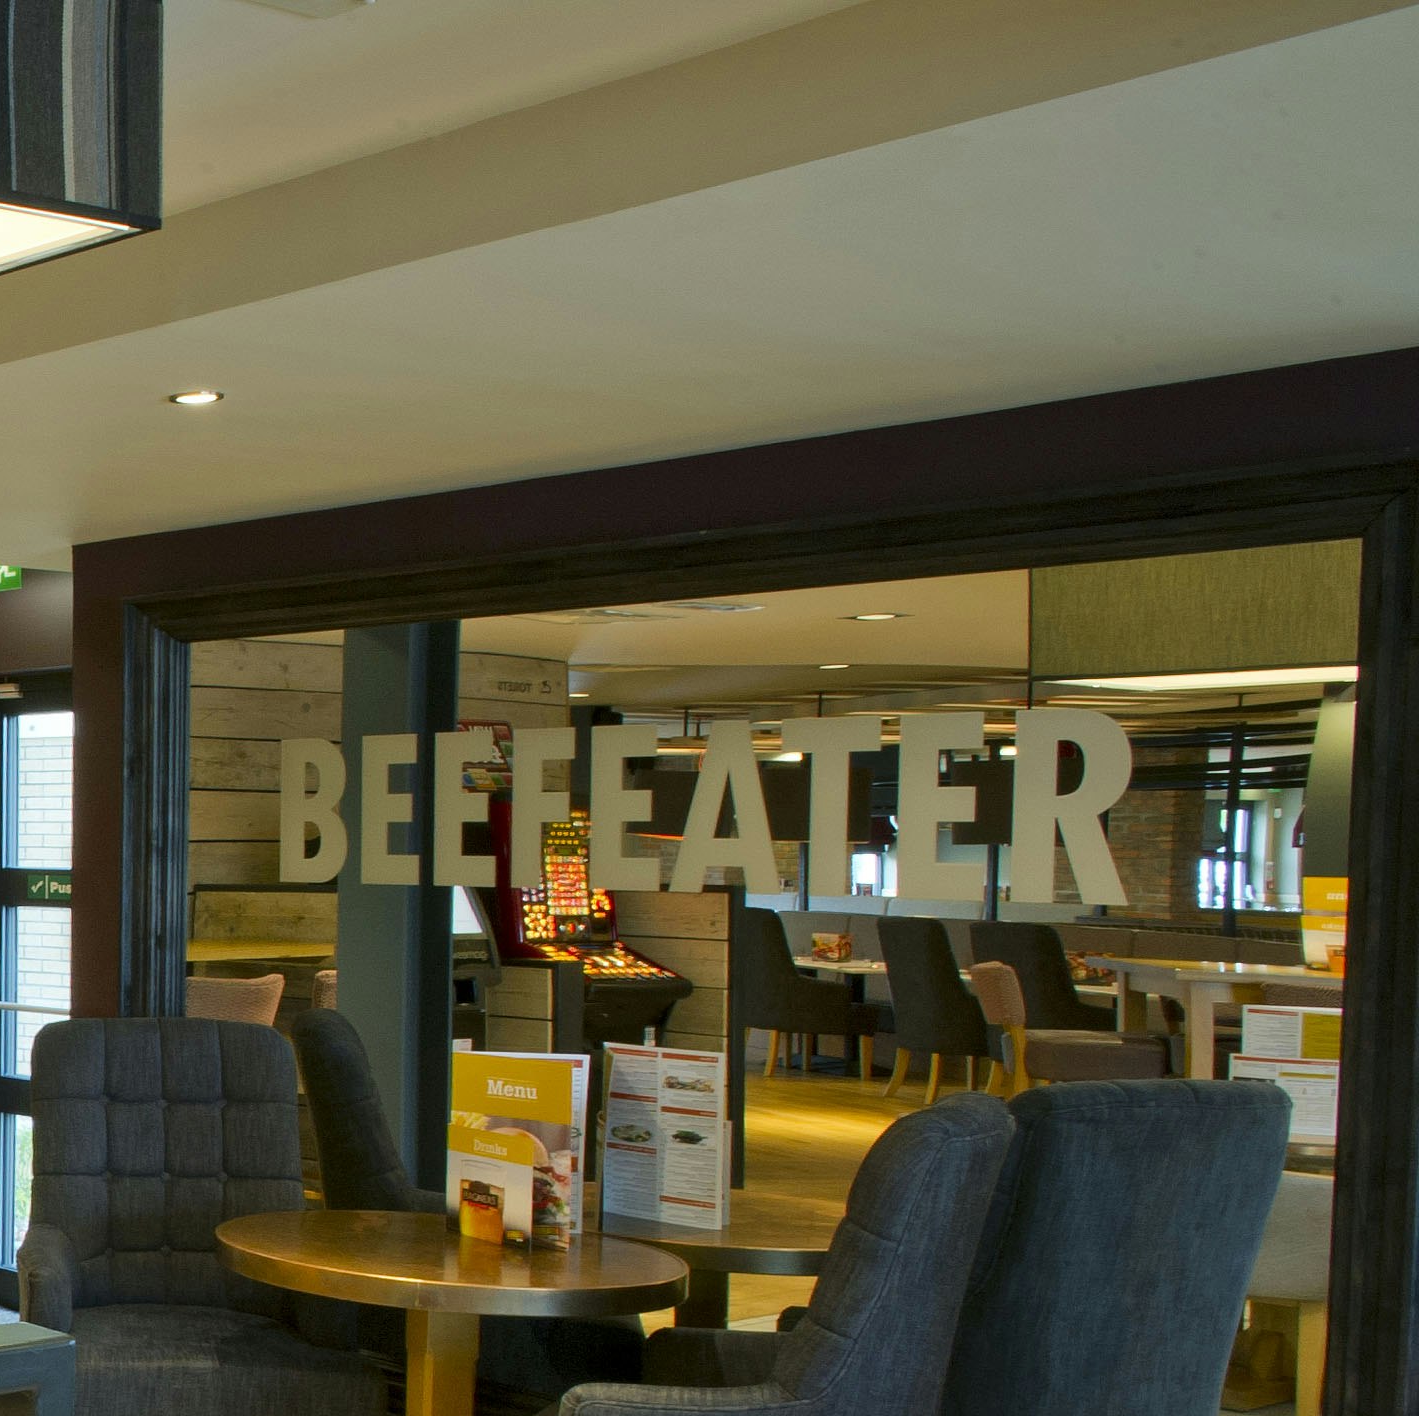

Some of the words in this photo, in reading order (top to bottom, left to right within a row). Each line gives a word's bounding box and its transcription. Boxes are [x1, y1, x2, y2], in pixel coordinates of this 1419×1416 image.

[278, 708, 1134, 907] BEEFEATER
[50, 881, 72, 895] Pus
[486, 1078, 538, 1100] Menu
[473, 1139, 508, 1157] Drinks
